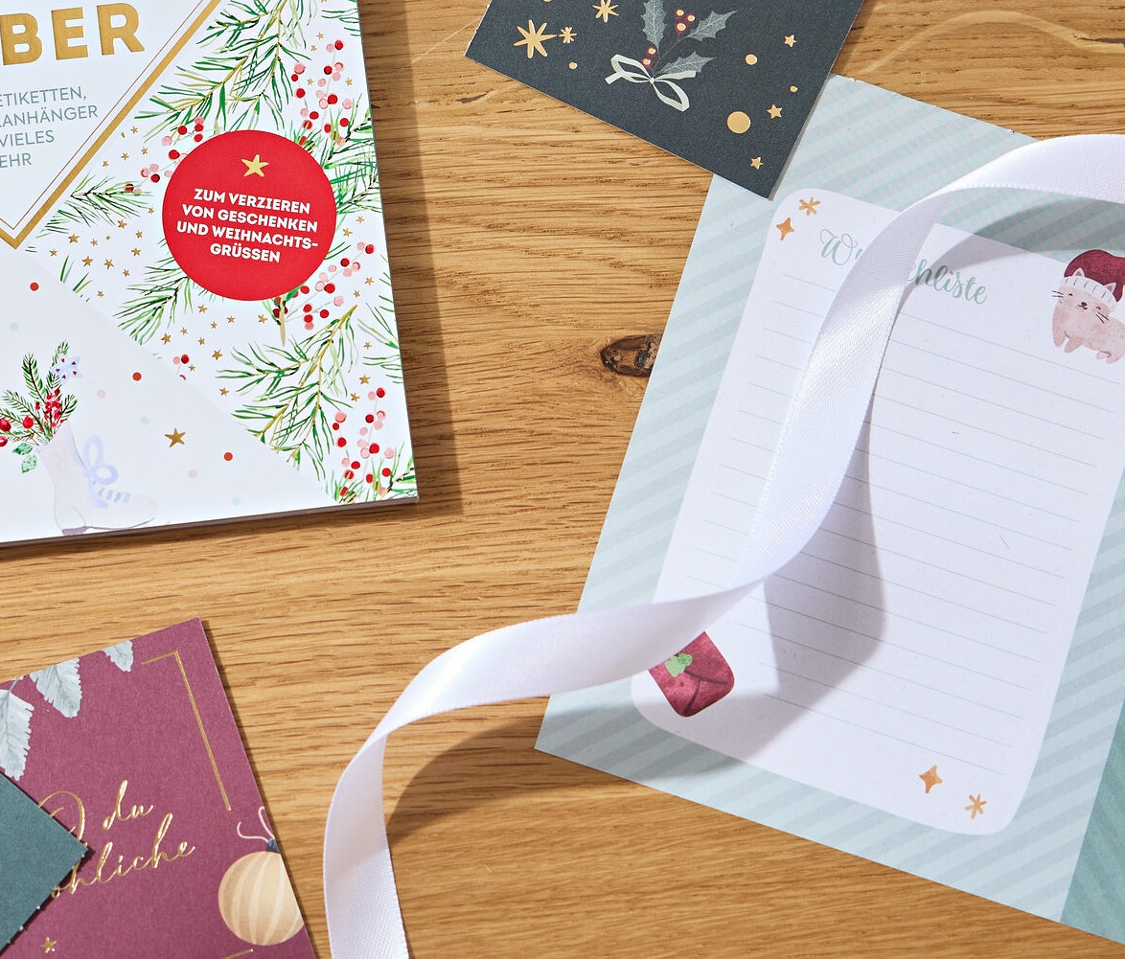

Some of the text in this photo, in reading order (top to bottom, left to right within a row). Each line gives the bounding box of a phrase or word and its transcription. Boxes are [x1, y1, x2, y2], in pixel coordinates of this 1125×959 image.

[193, 188, 311, 215] ZUM VERZIEREN
[182, 203, 318, 233] VON GESCHENKEN
[176, 220, 319, 250] UND WEIHNACHTS-
[210, 243, 281, 263] GRÜSSEN
[102, 780, 154, 831] du
